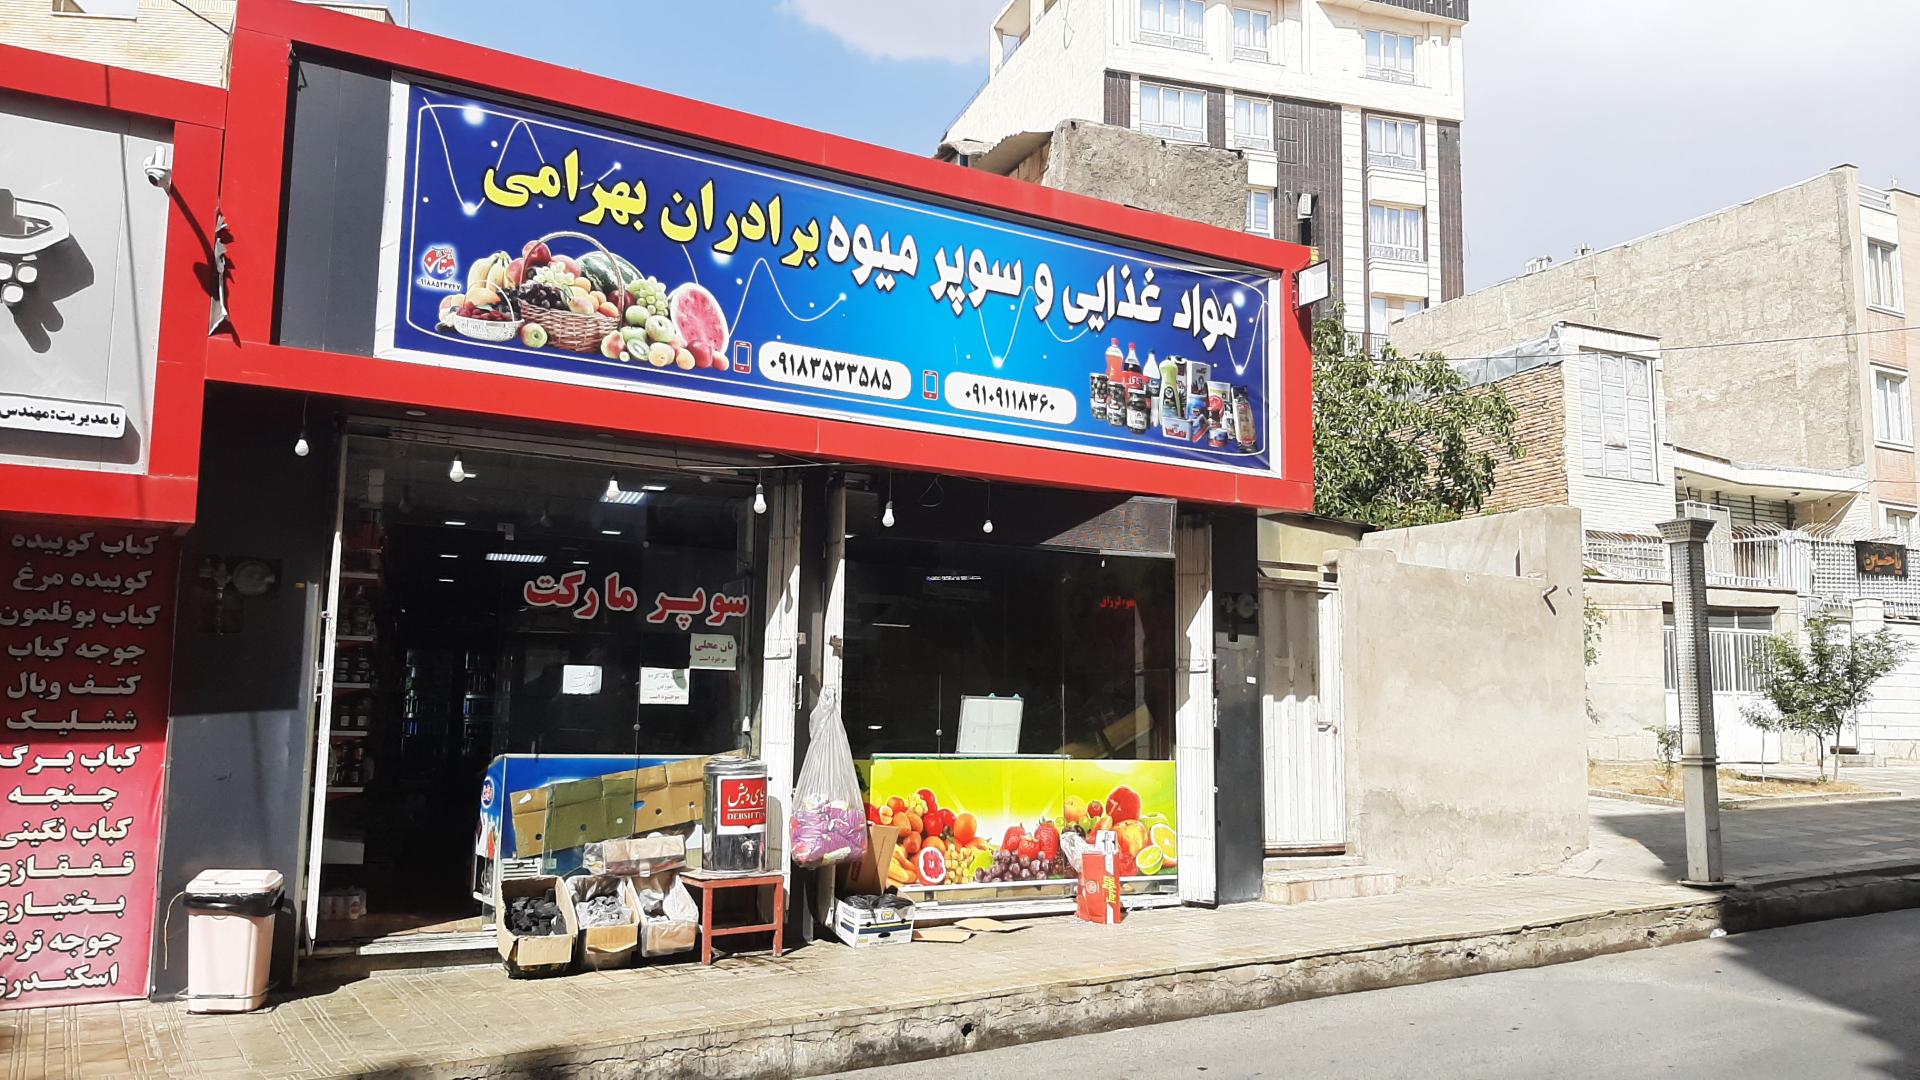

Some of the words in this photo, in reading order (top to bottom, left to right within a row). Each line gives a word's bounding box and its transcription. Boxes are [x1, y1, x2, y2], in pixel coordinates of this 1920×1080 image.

[484, 148, 648, 233] بهرامی
[660, 178, 822, 269] برادران
[827, 215, 919, 293] میوه
[930, 245, 1023, 317] سوپر
[1034, 262, 1056, 323] و
[1063, 265, 1163, 332] غذایی
[1173, 282, 1238, 353] مواد
[769, 351, 892, 391] ۰۹۱۸۳۵۳۳۵۸۵
[965, 382, 1055, 413] ۰۹۱۰۹۱۱۸۳۶۰
[11, 532, 95, 557] کوبیده
[100, 533, 159, 559] کباب
[12, 562, 64, 591] مرغ
[70, 570, 152, 595] کوبیده
[524, 570, 638, 619] مارکت
[647, 587, 749, 630] سوپر
[0, 600, 96, 629] بوقلمون
[102, 604, 161, 629] کباب
[7, 635, 69, 662] کباب
[75, 643, 146, 666] جوجه
[68, 674, 141, 695] کتف
[6, 709, 137, 735] ششلیک
[0, 745, 75, 775] برگ
[80, 744, 142, 773] کباب
[7, 784, 119, 811] چنجه
[0, 817, 66, 849] نگینی
[71, 816, 134, 847] کباب
[48, 932, 122, 958] جوجه
